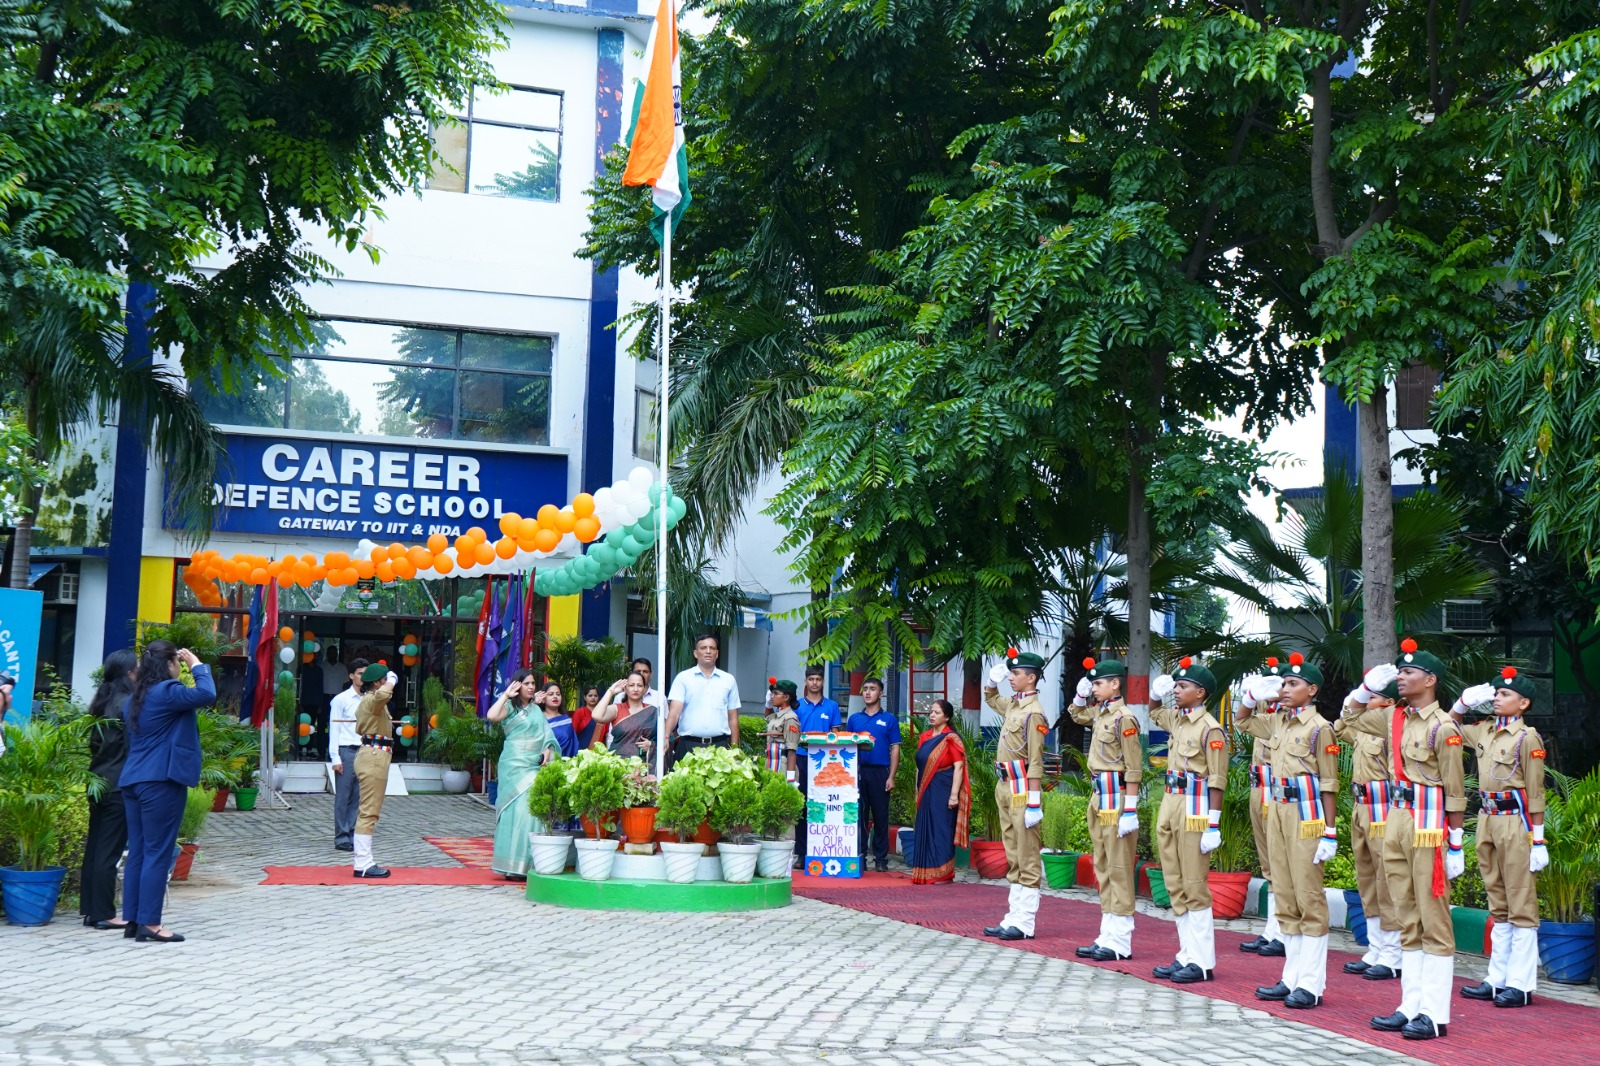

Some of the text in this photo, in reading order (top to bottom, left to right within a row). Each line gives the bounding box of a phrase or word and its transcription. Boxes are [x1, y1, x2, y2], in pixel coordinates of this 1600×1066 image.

[261, 443, 481, 492] CAREER
[373, 491, 507, 520] SCHOOL
[278, 516, 461, 537] GATEWAY TO IIT & NDA
[828, 793, 840, 802] JAI
[826, 804, 843, 812] HIND
[809, 824, 856, 837] GLORY TO
[823, 835, 844, 847] OUR
[812, 845, 852, 857] NATION
